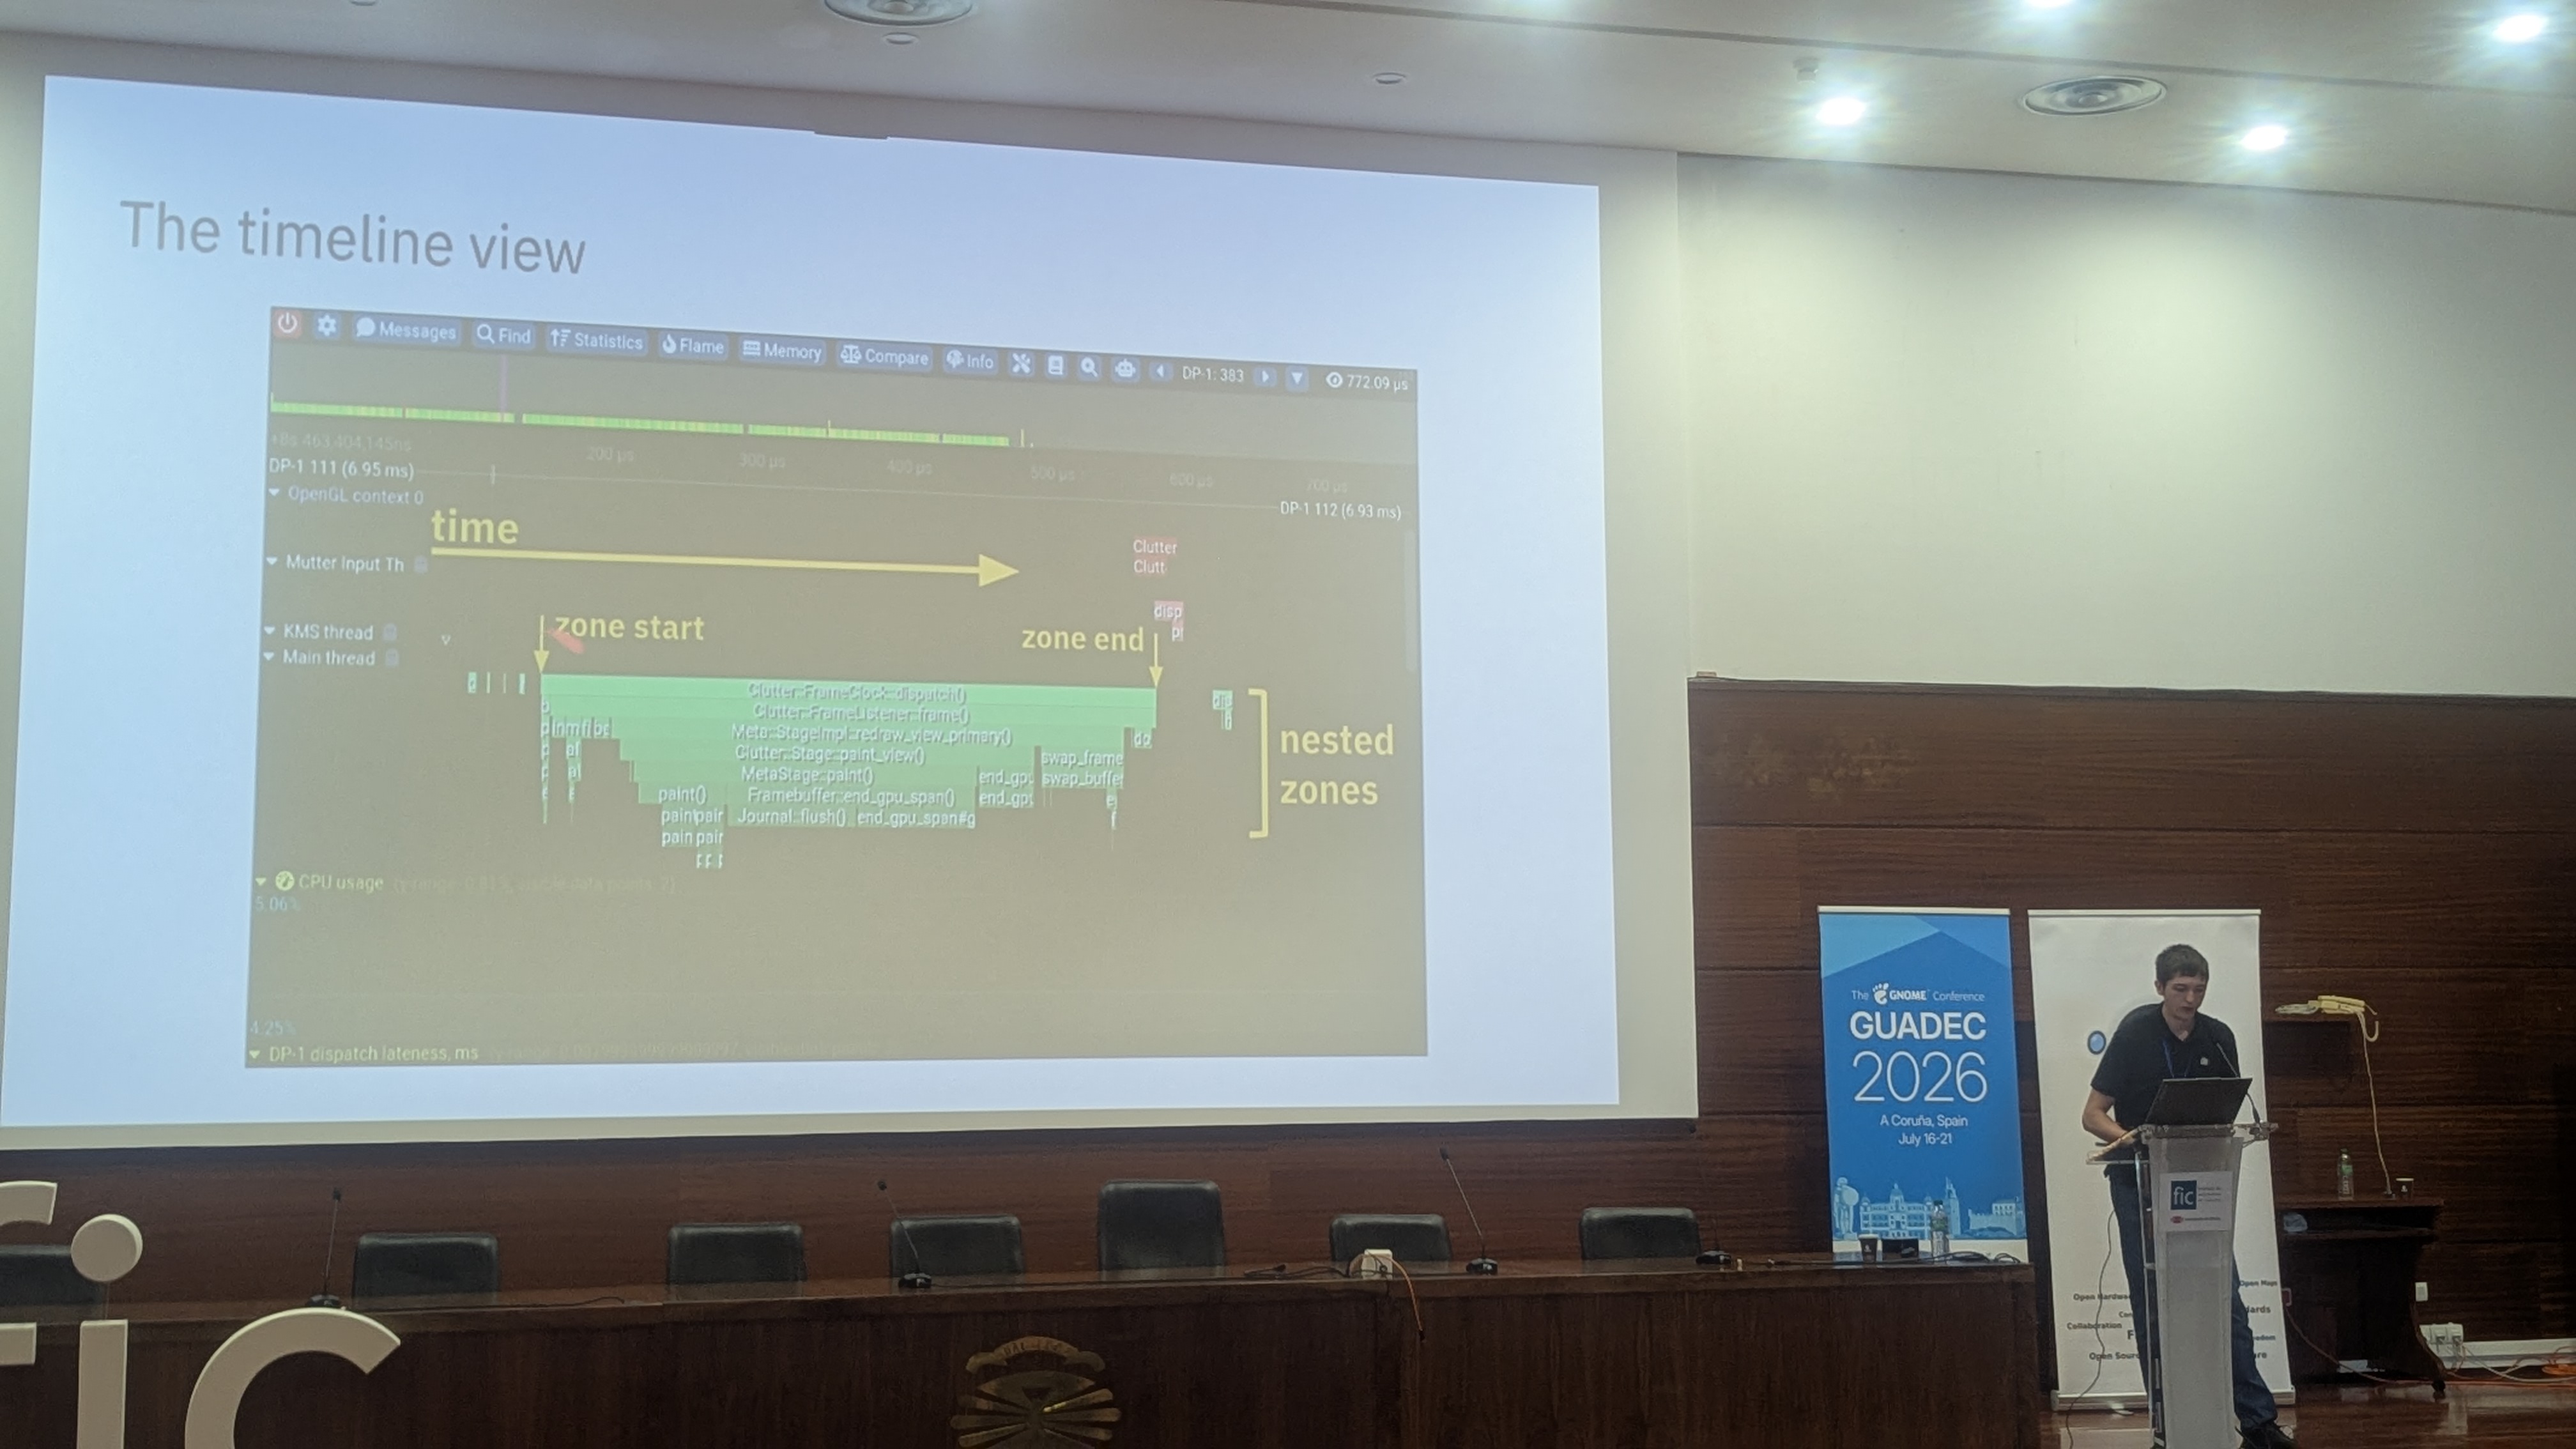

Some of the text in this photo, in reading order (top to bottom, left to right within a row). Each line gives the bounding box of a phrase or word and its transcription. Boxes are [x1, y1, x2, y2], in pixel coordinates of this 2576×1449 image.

[120, 199, 586, 275] The timeline view
[380, 321, 457, 341] Messages
[498, 327, 532, 345] Find
[575, 332, 643, 351] Statistics
[680, 338, 725, 355] Flame
[764, 342, 822, 364] Memory
[864, 348, 930, 368] Compare
[967, 353, 994, 370] Info
[1220, 367, 1245, 383] 383
[1347, 375, 1390, 390] 772.09
[268, 458, 303, 474] DP-1
[310, 459, 337, 475] 111
[385, 462, 415, 482] ms)
[288, 484, 424, 505] OpenGL context 0
[1280, 501, 1310, 516] DP-1
[1315, 502, 1338, 516] 112
[1377, 505, 1402, 521] ms)
[432, 509, 519, 544] time
[1133, 539, 1177, 554] Clutter
[286, 554, 404, 574] Mutter Input Th
[283, 624, 374, 640] KMS thread
[555, 615, 705, 641] zone start
[1022, 626, 1144, 652] zone end
[283, 650, 376, 666] Main thread
[1280, 723, 1395, 756] nested
[1041, 750, 1123, 767] swap_frame
[658, 785, 706, 806] paint()
[1280, 779, 1379, 805] zones
[299, 875, 332, 890] CPU
[336, 877, 385, 894] usage
[1851, 990, 1985, 1002] The GNOME Conference
[1850, 1011, 1987, 1040] GUADEC
[269, 1045, 305, 1062] DP-1
[310, 1045, 378, 1064] dispatch
[455, 1046, 479, 1061] ms
[1853, 1050, 1988, 1103] 2026
[1880, 1114, 1968, 1129] A Coruña, Spain
[1898, 1133, 1953, 1147] July 16-21
[2173, 1186, 2194, 1206] fic
[2073, 1293, 2096, 1302] Open
[2066, 1321, 2122, 1331] Collaboration
[2089, 1352, 2113, 1361] Open
